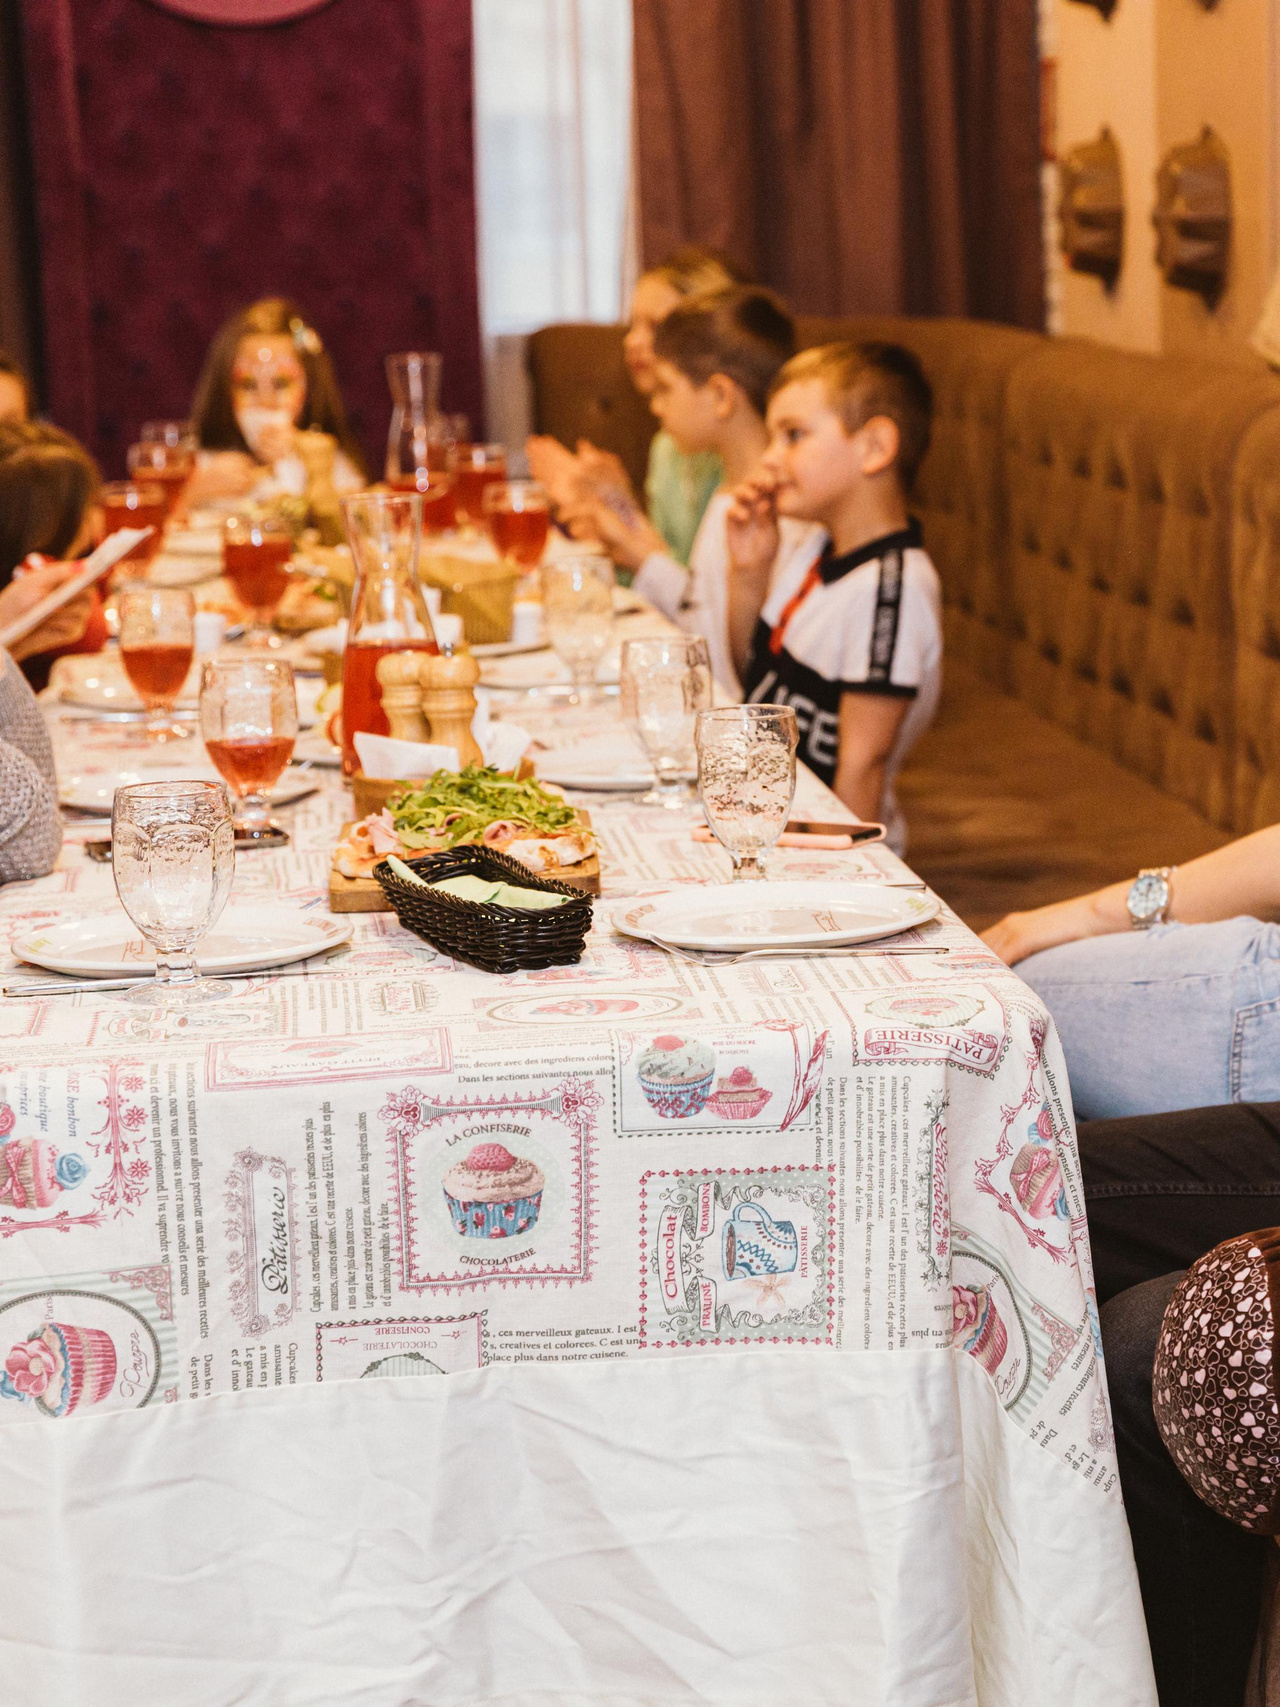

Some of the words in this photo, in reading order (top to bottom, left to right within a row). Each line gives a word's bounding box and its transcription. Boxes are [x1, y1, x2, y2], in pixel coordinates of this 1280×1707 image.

[876, 1030, 984, 1060] PATISSERIE
[826, 1076, 835, 1086] de
[838, 1076, 847, 1096] Dans
[855, 1075, 863, 1083] et
[867, 1075, 876, 1085] Le
[824, 1087, 835, 1104] petit
[878, 1081, 886, 1096] mis
[900, 1075, 911, 1112] Cupcakes
[838, 1097, 847, 1108] les
[865, 1086, 874, 1111] gateau
[878, 1097, 885, 1107] en
[35, 1085, 51, 1132] boutique
[66, 1096, 80, 1138] bonbon
[824, 1106, 834, 1137] gateaux,
[838, 1109, 847, 1139] sections
[876, 1108, 887, 1129] place
[445, 1135, 462, 1147] LA
[463, 1124, 532, 1138] CONFISERIE
[815, 1126, 822, 1134] et
[876, 1130, 887, 1147] plus
[890, 1118, 898, 1152] creatives
[814, 1135, 824, 1164] devenir
[838, 1141, 846, 1176] suivantes
[878, 1147, 887, 1166] dans
[890, 1153, 897, 1161] et
[901, 1131, 910, 1177] merveilleux
[853, 1139, 864, 1181] possibilites
[866, 1162, 875, 1172] de
[855, 1185, 863, 1195] de
[864, 1173, 874, 1191] petit
[700, 1182, 711, 1232] BOMBONS
[838, 1197, 847, 1221] allons
[854, 1205, 863, 1224] faire.
[864, 1192, 873, 1219] gateau,
[900, 1217, 908, 1228] est
[836, 1221, 845, 1258] presenter
[865, 1221, 874, 1246] decore
[900, 1235, 906, 1246] un
[460, 1247, 536, 1266] CHOCOLATERIE
[662, 1214, 678, 1299] Chocolat
[900, 1248, 908, 1261] des
[864, 1266, 873, 1279] des
[888, 1261, 897, 1271] de
[837, 1275, 845, 1293] serie
[897, 1262, 907, 1302] patisseries
[701, 1282, 711, 1327] PRALINÉ
[837, 1295, 846, 1308] des
[862, 1281, 872, 1321] ingrediens
[887, 1301, 895, 1309] et
[887, 1310, 896, 1320] de
[375, 1327, 430, 1336] CONFISERIE
[497, 1329, 513, 1337] ces
[515, 1327, 572, 1337] merveilleux
[574, 1327, 614, 1338] gateaux.
[617, 1324, 620, 1333] I
[623, 1325, 637, 1333] est
[863, 1322, 872, 1349] colores
[885, 1321, 896, 1338] plus
[363, 1341, 438, 1351] CHOCOLATERIE
[498, 1341, 541, 1349] creatives
[542, 1341, 552, 1349] et
[554, 1339, 596, 1349] colorees.
[598, 1337, 607, 1346] C
[609, 1338, 623, 1346] est
[887, 1340, 893, 1350] en
[896, 1331, 908, 1348] plus
[245, 1346, 255, 1358] Le
[486, 1352, 512, 1363] place
[513, 1352, 534, 1363] plus
[535, 1352, 559, 1361] dans
[561, 1353, 587, 1361] notre
[203, 1353, 213, 1377] Dans
[285, 1342, 299, 1384] Cupcakes
[188, 1369, 200, 1390] petit
[242, 1359, 253, 1388] gateau
[204, 1377, 213, 1390] les
